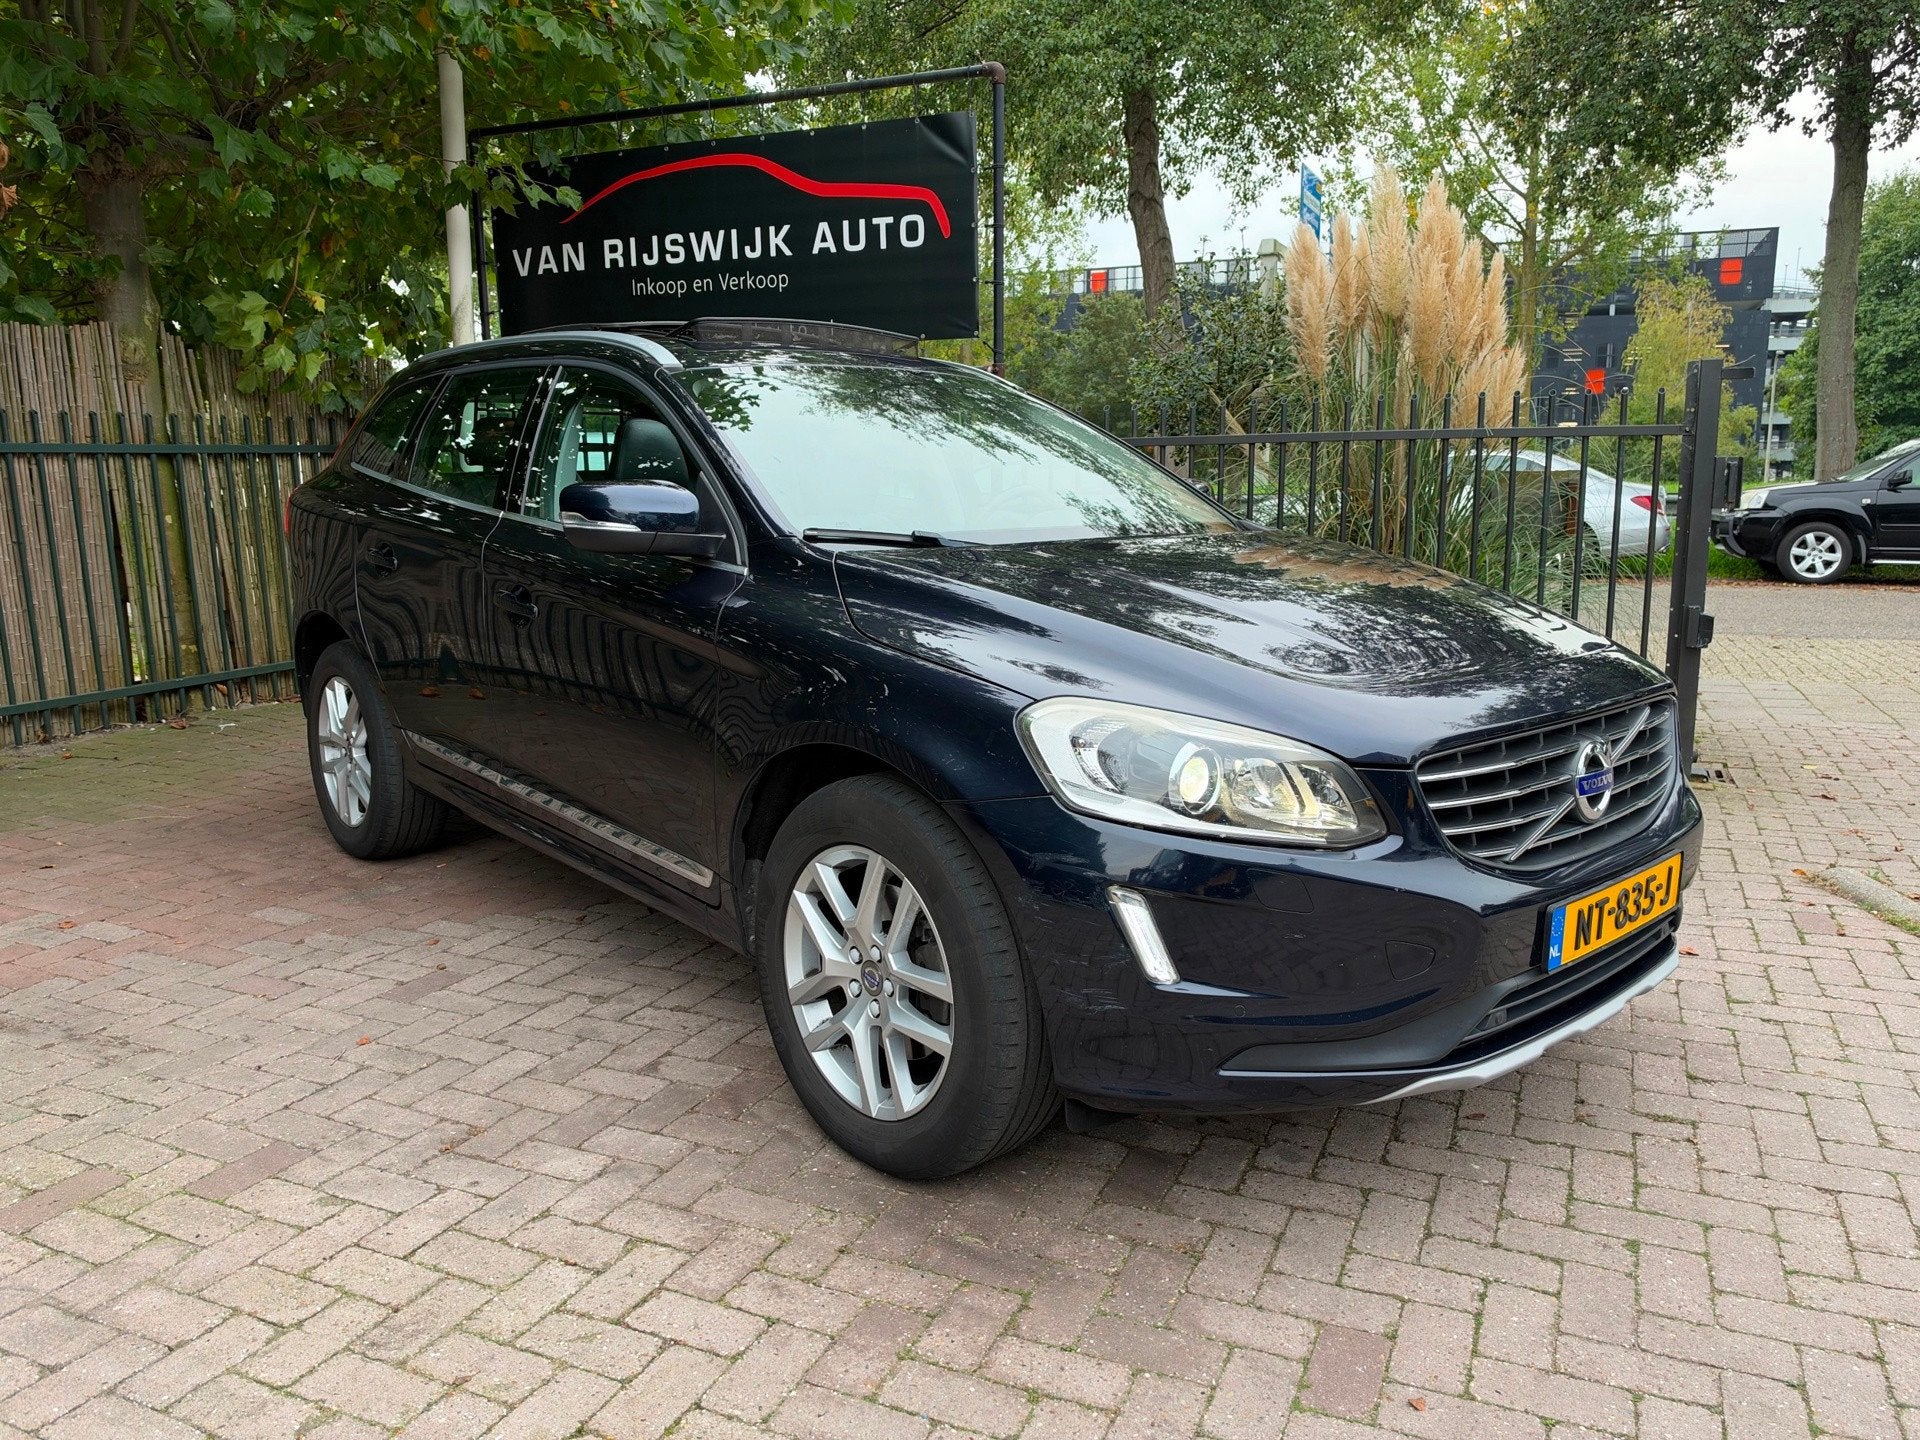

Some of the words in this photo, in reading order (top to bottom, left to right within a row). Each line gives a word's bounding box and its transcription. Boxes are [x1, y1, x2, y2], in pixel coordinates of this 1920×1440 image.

[512, 241, 586, 277] VAN
[603, 224, 794, 269] RIJSWIJK
[811, 213, 926, 255] AUTO
[631, 276, 688, 299] Inkoop
[692, 277, 714, 293] en
[718, 270, 790, 293] Verkoop
[1580, 773, 1613, 791] VOLVO
[1574, 865, 1674, 951] NT-835-J
[1549, 944, 1561, 960] NL
